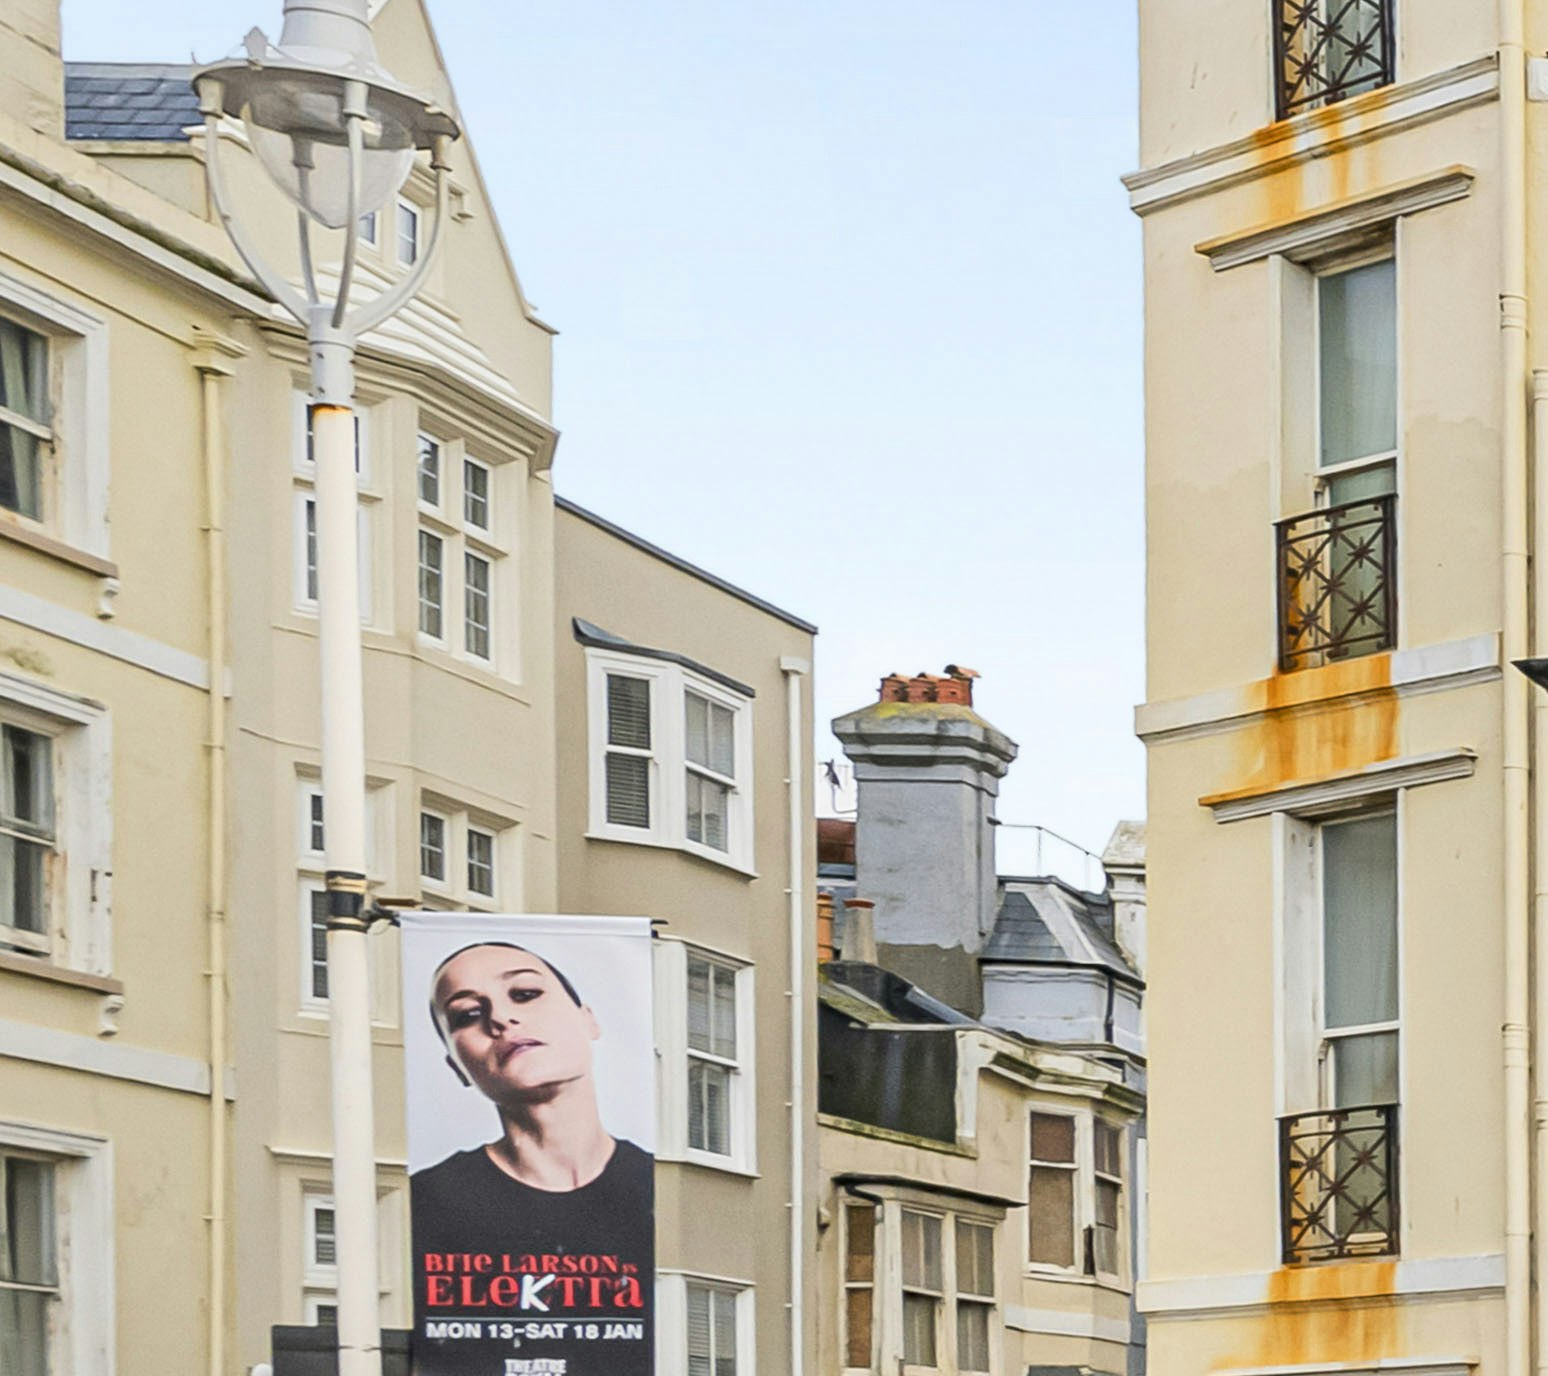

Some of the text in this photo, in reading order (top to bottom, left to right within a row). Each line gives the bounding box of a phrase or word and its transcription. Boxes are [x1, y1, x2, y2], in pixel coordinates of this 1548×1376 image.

[426, 1322, 482, 1339] MON
[574, 1325, 600, 1339] 18
[602, 1324, 644, 1340] JAN
